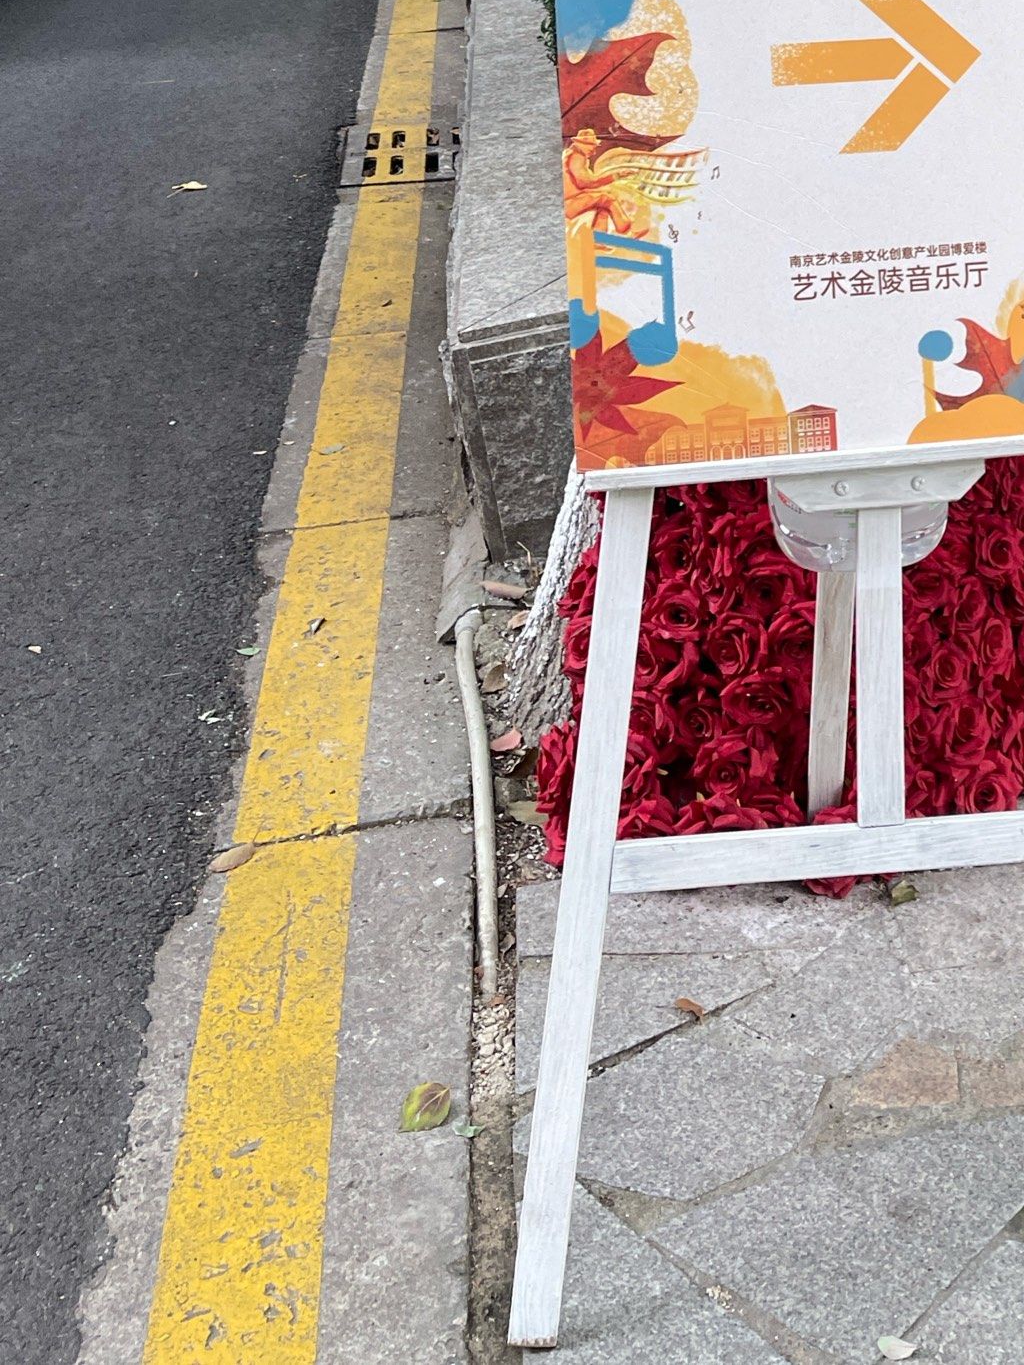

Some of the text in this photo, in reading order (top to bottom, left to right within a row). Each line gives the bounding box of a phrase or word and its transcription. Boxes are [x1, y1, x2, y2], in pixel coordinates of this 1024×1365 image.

[789, 241, 988, 268] 南京艺术金陵文化创意产业园博爱楼
[791, 261, 989, 302] 艺术金陵音乐厅
